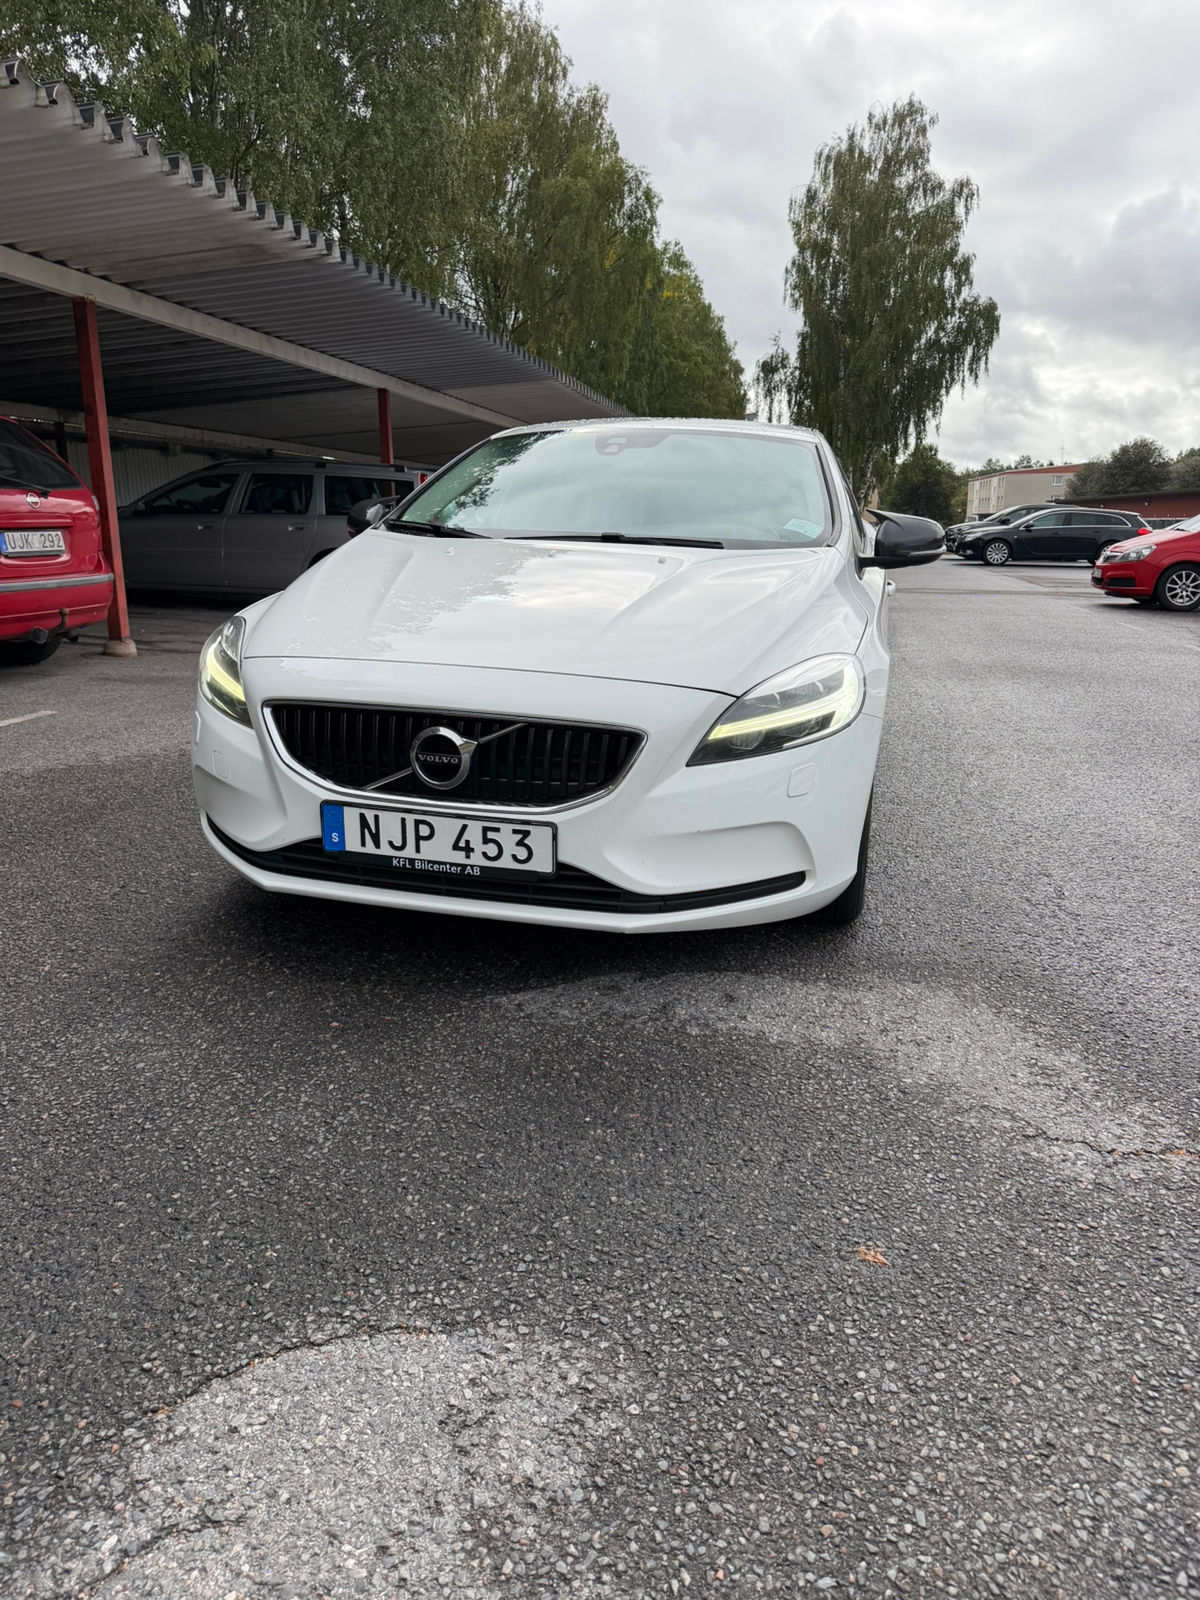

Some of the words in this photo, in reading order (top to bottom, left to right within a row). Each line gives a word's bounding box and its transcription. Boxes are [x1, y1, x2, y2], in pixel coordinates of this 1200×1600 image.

[6, 533, 33, 549] UJK
[40, 533, 63, 549] 292
[417, 754, 459, 764] VOLVO
[331, 832, 339, 843] S
[359, 812, 436, 854] NJP
[452, 823, 534, 865] 453
[392, 857, 412, 869] KFL
[415, 860, 461, 874] Bilcenter
[465, 865, 481, 876] AB
